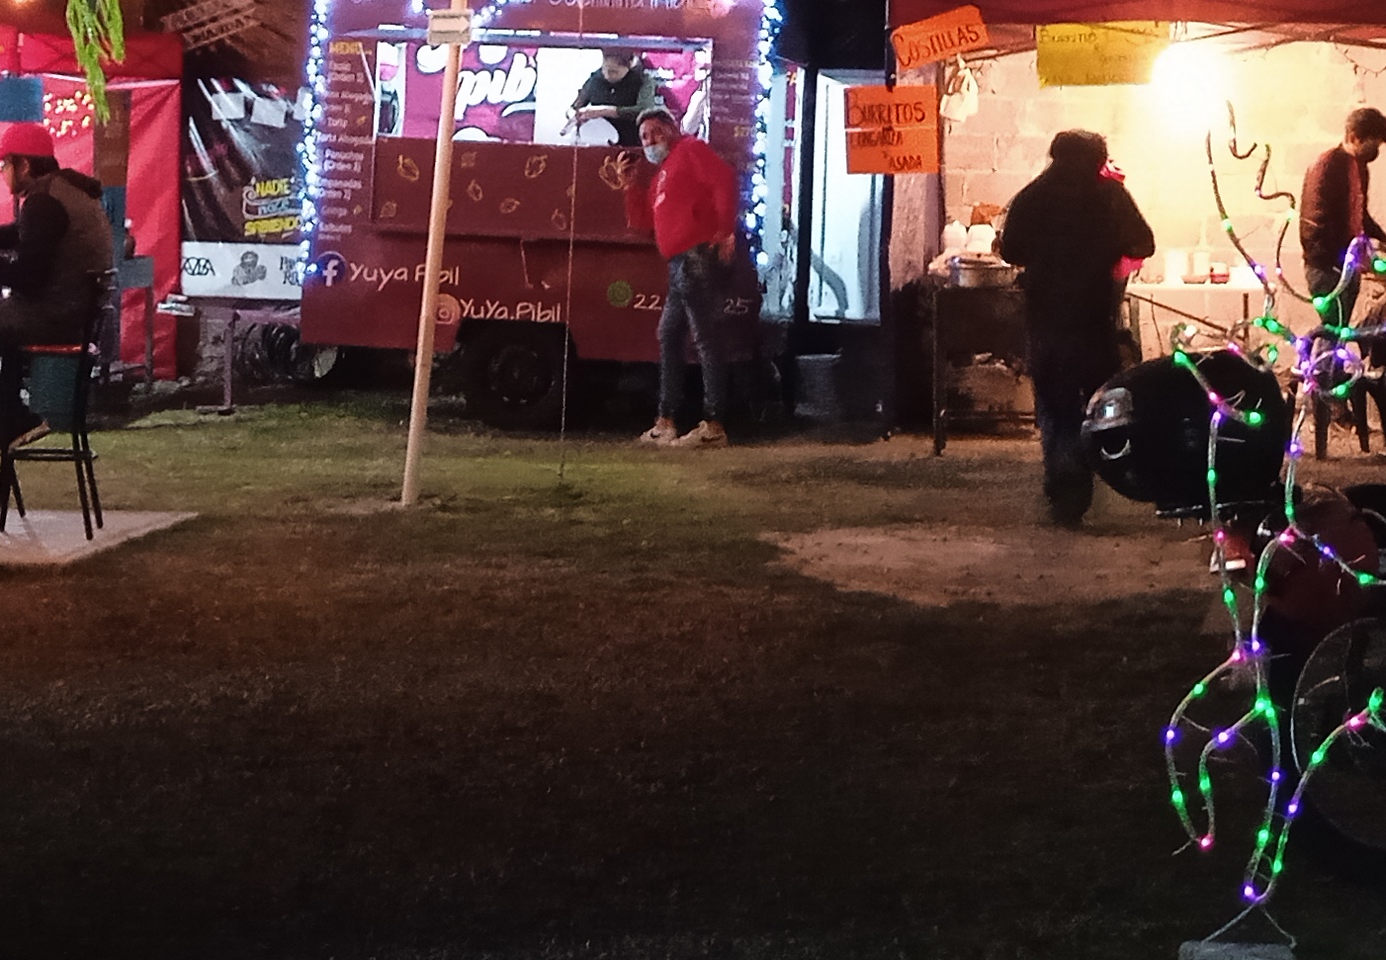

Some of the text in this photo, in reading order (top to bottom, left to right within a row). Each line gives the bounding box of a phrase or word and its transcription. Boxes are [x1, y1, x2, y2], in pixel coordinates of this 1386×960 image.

[892, 24, 980, 68] COSTILLAS
[455, 51, 537, 121] pib
[847, 92, 925, 126] BURRITOS
[349, 262, 460, 291] Yuya Pbil
